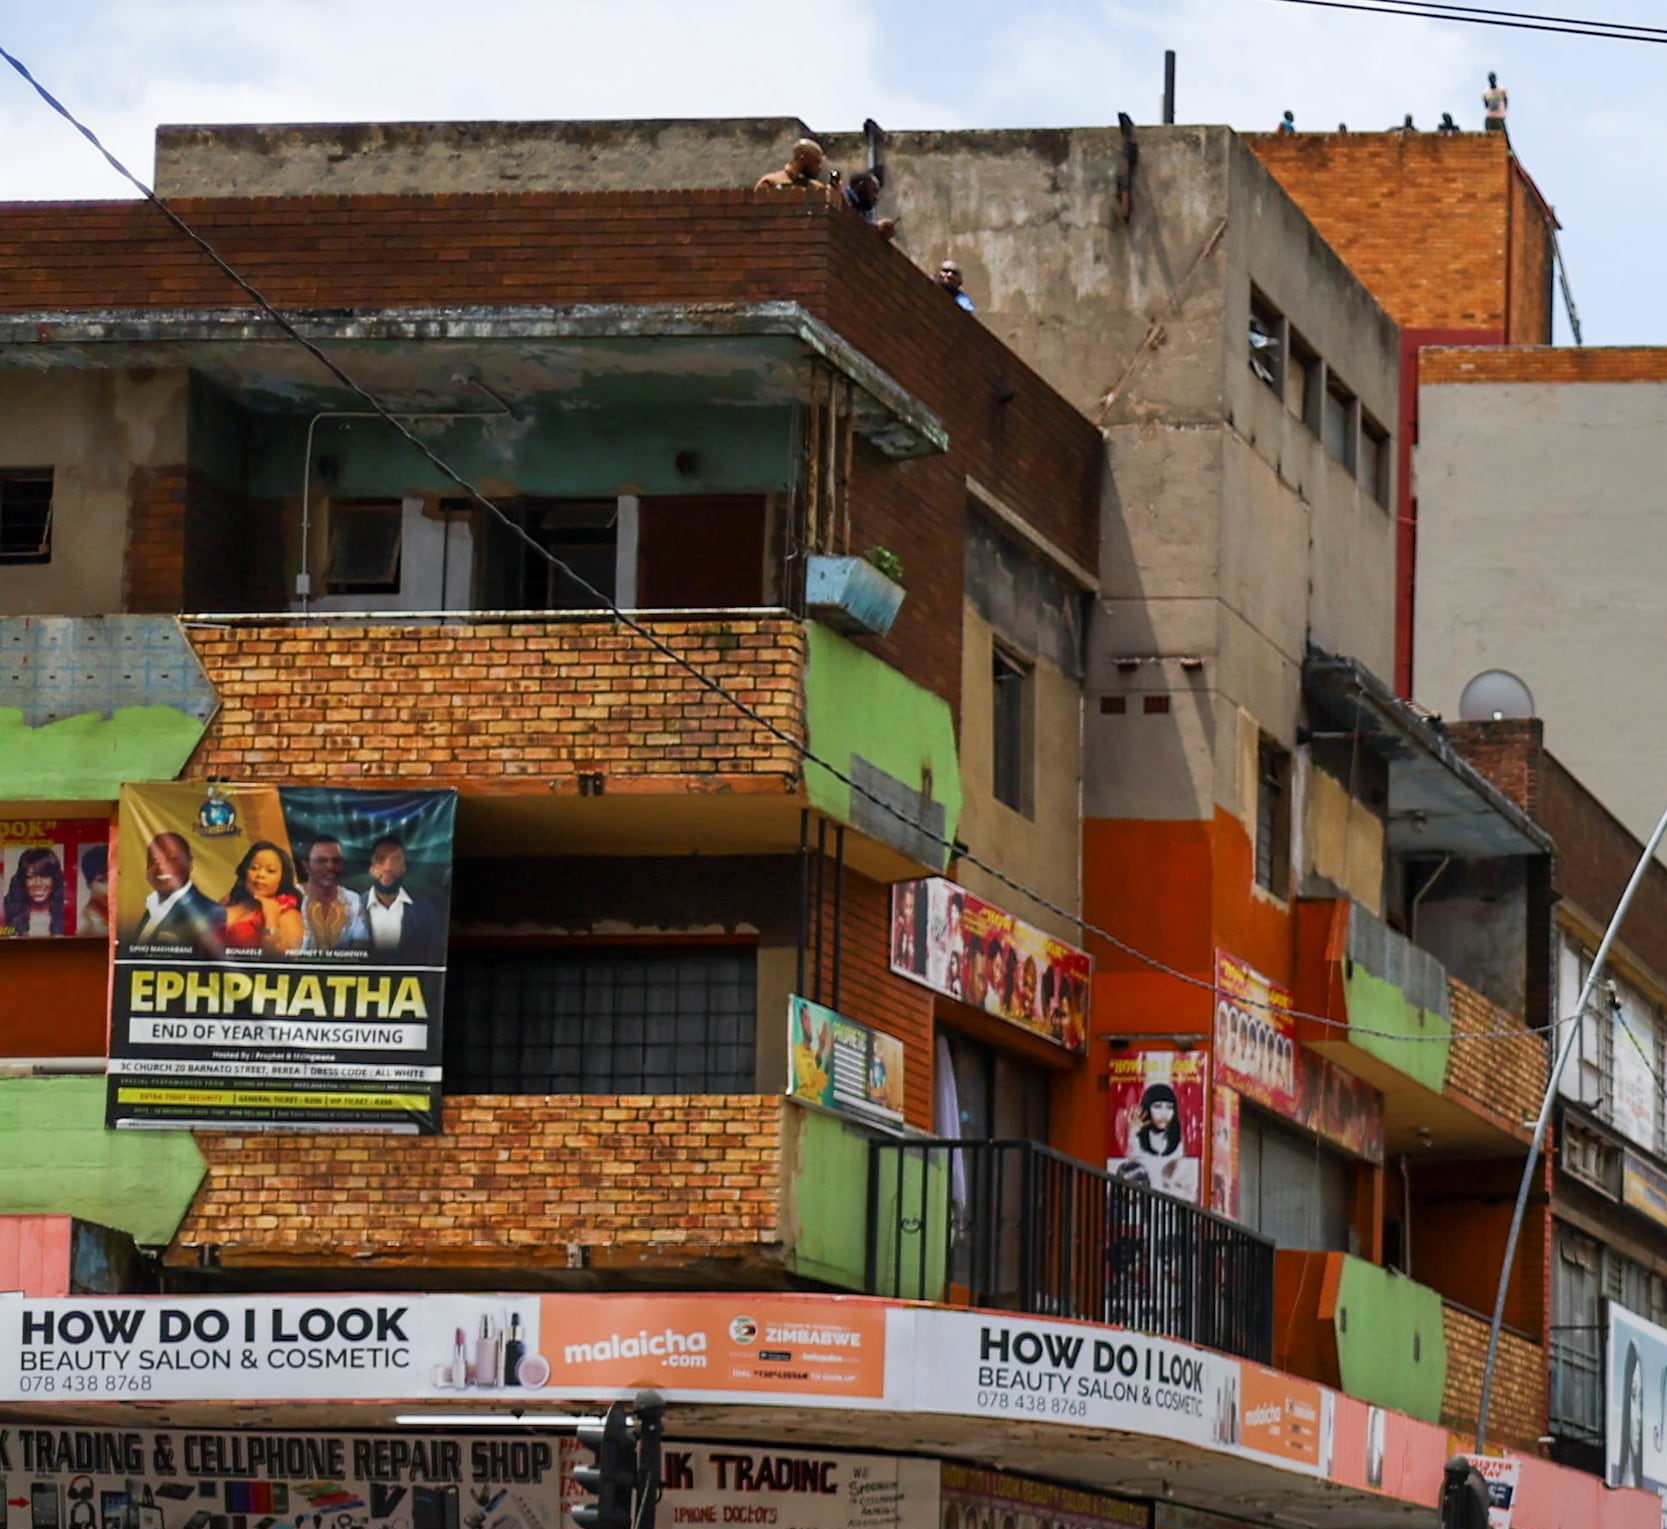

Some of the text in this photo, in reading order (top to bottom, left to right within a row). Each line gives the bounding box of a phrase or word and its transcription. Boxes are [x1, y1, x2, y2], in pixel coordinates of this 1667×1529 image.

[130, 970, 428, 1018] EPHPHATHA
[152, 1024, 403, 1044] END OF YEAR THANKSGIVING
[134, 1063, 231, 1073] CHURCH BARNATO
[394, 1070, 425, 1078] WHITE
[22, 1307, 410, 1345] HOW DO I LOOK
[765, 1327, 861, 1348] ZIMBABWE
[20, 1347, 410, 1372] BEAUTY SALON & COSMETIC
[564, 1329, 708, 1365] malaicha
[661, 1353, 708, 1370] .com
[979, 1327, 1203, 1394] HOW DO I LOOK
[20, 1374, 153, 1393] 078 438 8768
[978, 1365, 1203, 1419] BEAUTY SALON & COSMETIC
[977, 1390, 1087, 1417] 078 438 8768
[19, 1427, 146, 1473] TRADING
[152, 1434, 179, 1475] &
[184, 1434, 346, 1481] CELLPHONE
[353, 1435, 463, 1483] REPAIR
[470, 1439, 553, 1483] SHOP
[709, 1454, 838, 1494] TRADING
[673, 1505, 717, 1521] IPHONE
